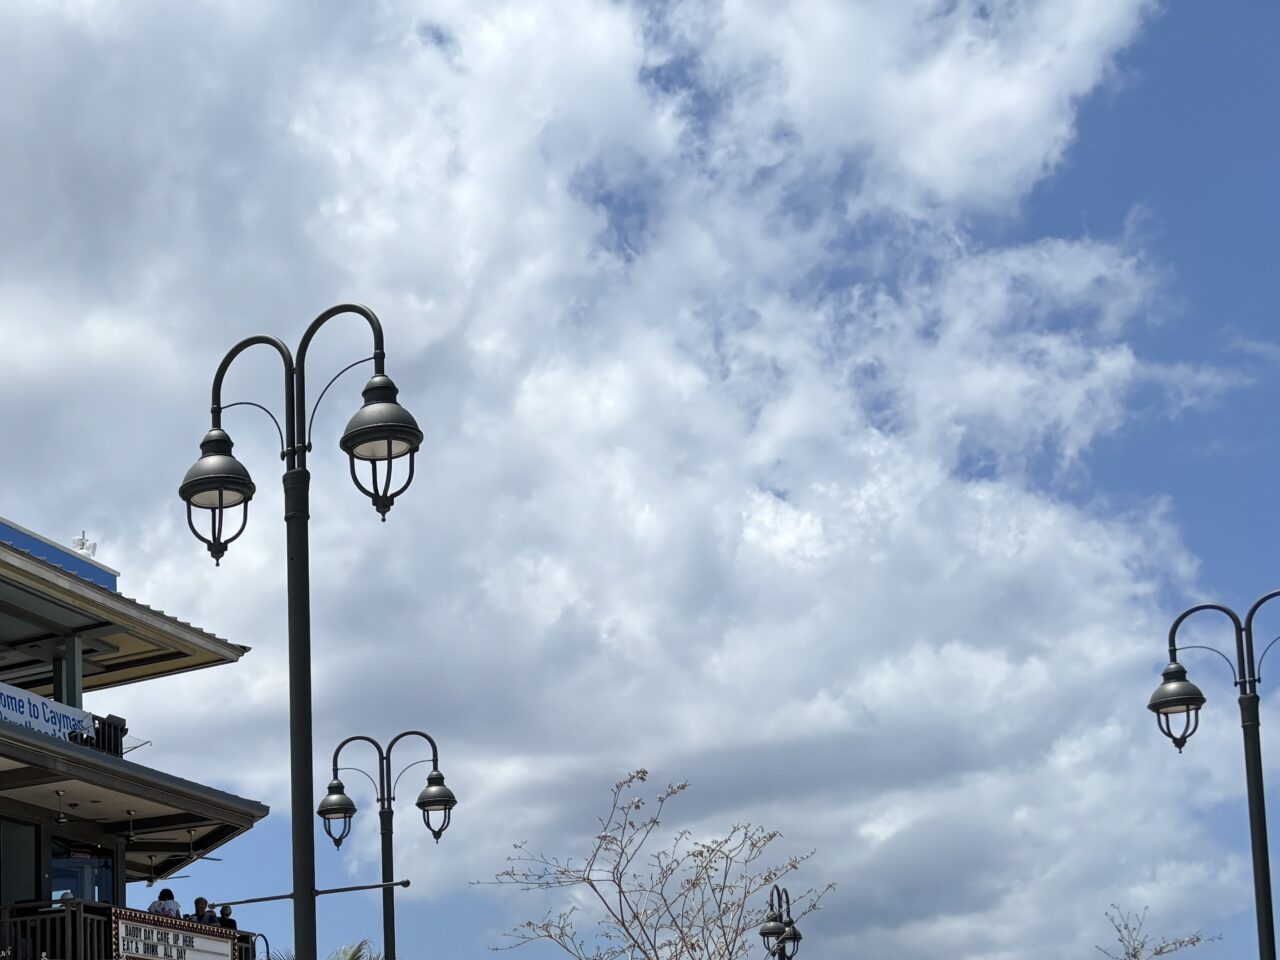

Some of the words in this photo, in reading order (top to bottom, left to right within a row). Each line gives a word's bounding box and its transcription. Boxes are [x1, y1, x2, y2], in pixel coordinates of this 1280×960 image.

[27, 697, 40, 720] to
[143, 925, 154, 941] DAY
[173, 933, 179, 945] UP
[182, 934, 195, 948] HERE
[122, 939, 133, 952] EAT
[143, 942, 158, 957] DRINK
[164, 946, 173, 959] ALL
[177, 948, 186, 960] DAY
